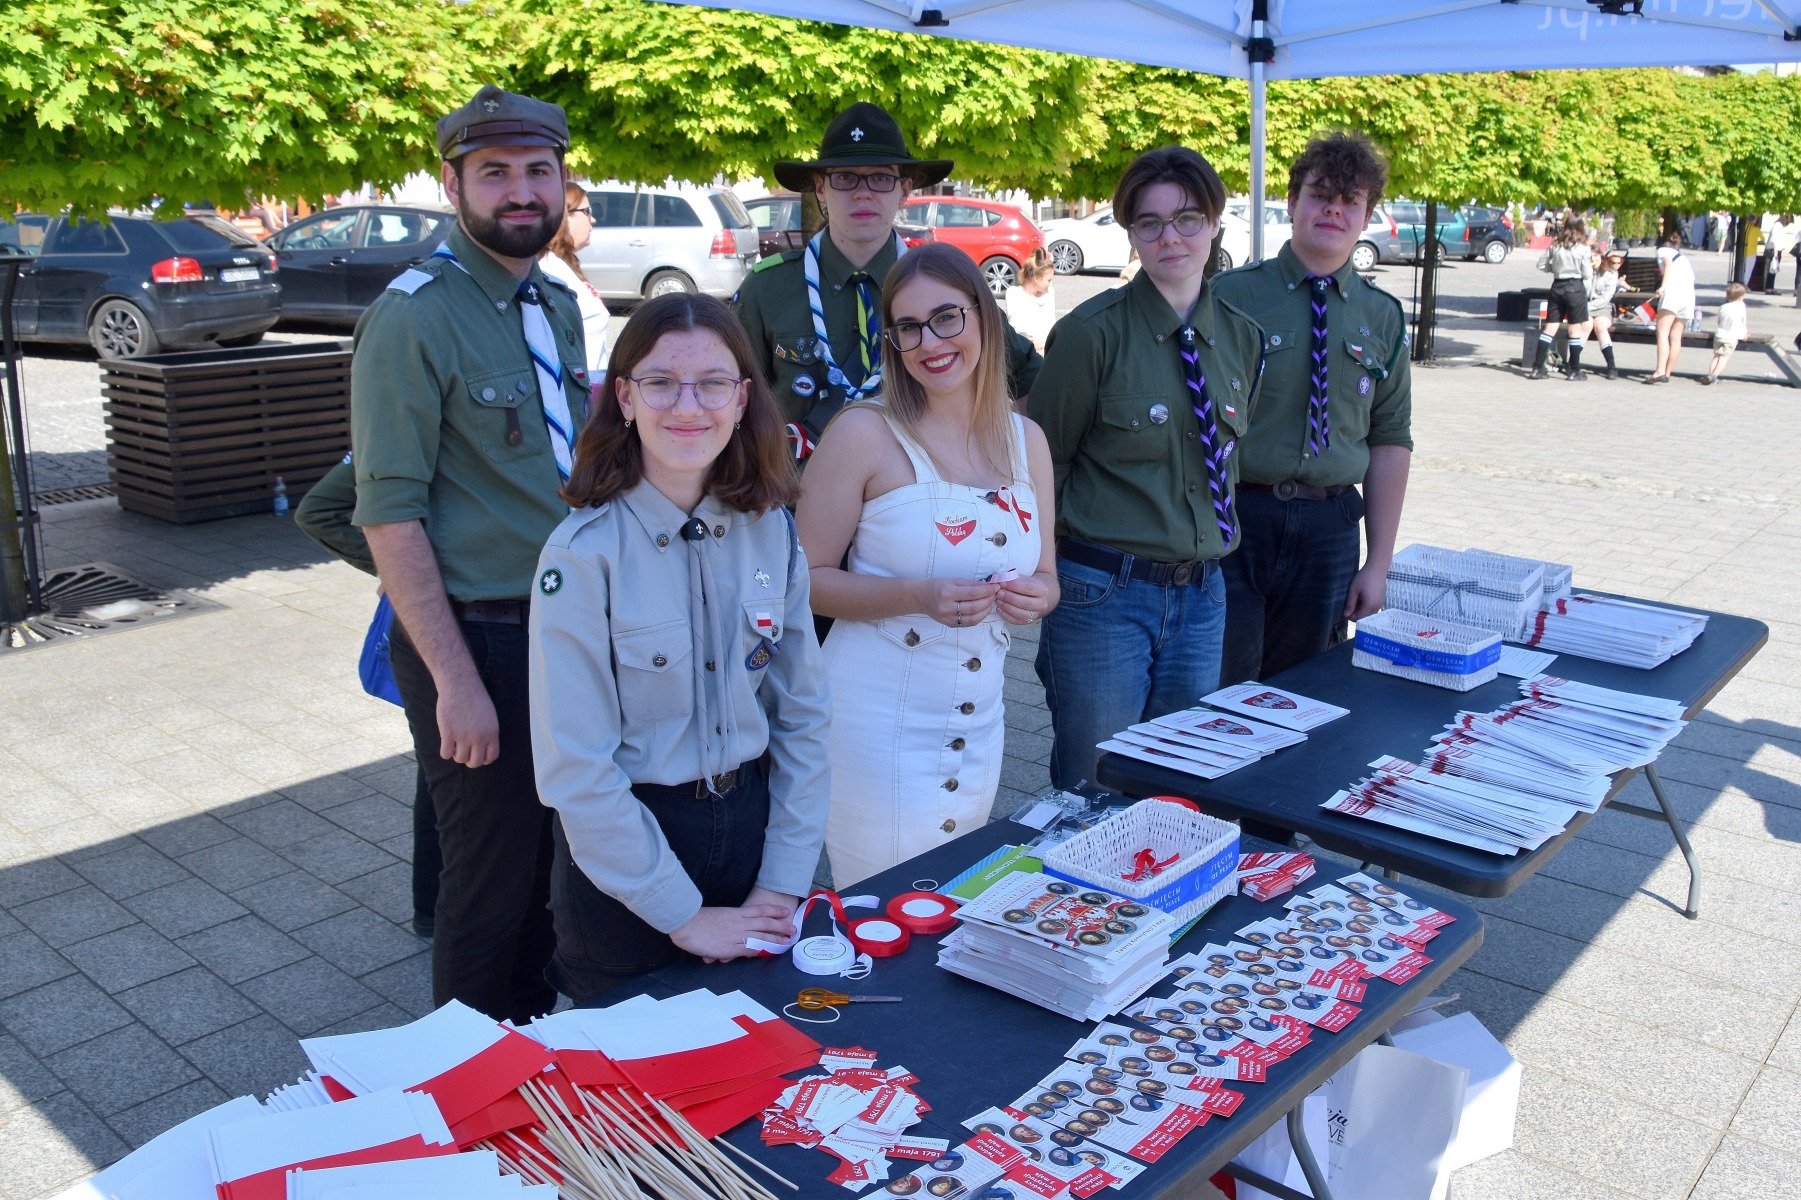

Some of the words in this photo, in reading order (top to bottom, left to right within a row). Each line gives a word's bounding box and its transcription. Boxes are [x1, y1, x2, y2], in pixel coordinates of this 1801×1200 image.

[795, 1102, 806, 1114] 1791
[778, 1120, 796, 1130] maja
[797, 1127, 814, 1136] 1791
[988, 1139, 1001, 1148] maja
[977, 1145, 995, 1158] Twórcy
[1034, 1172, 1049, 1181] maja
[1073, 1173, 1093, 1185] Twórcy
[1025, 1180, 1045, 1193] Twórcy
[1090, 1180, 1104, 1188] maja
